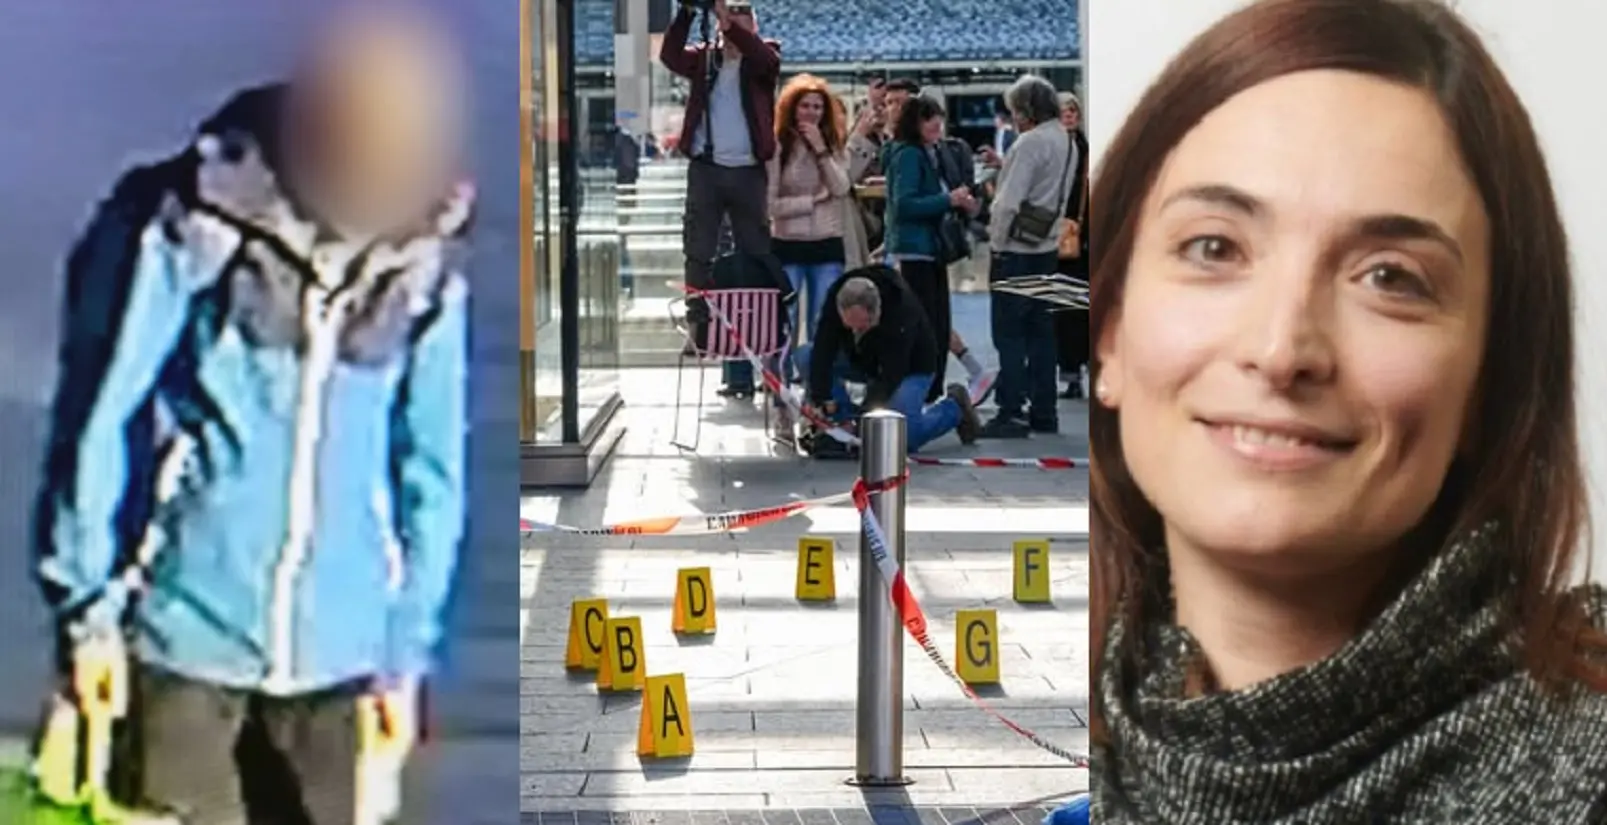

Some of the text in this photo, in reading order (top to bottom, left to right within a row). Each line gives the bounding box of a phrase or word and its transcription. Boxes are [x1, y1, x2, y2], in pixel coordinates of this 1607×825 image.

[806, 546, 822, 585] E
[1024, 548, 1040, 587] F
[688, 576, 707, 617] D
[585, 607, 604, 654] C
[616, 626, 637, 673] B
[966, 619, 991, 667] G
[662, 684, 684, 738] A
